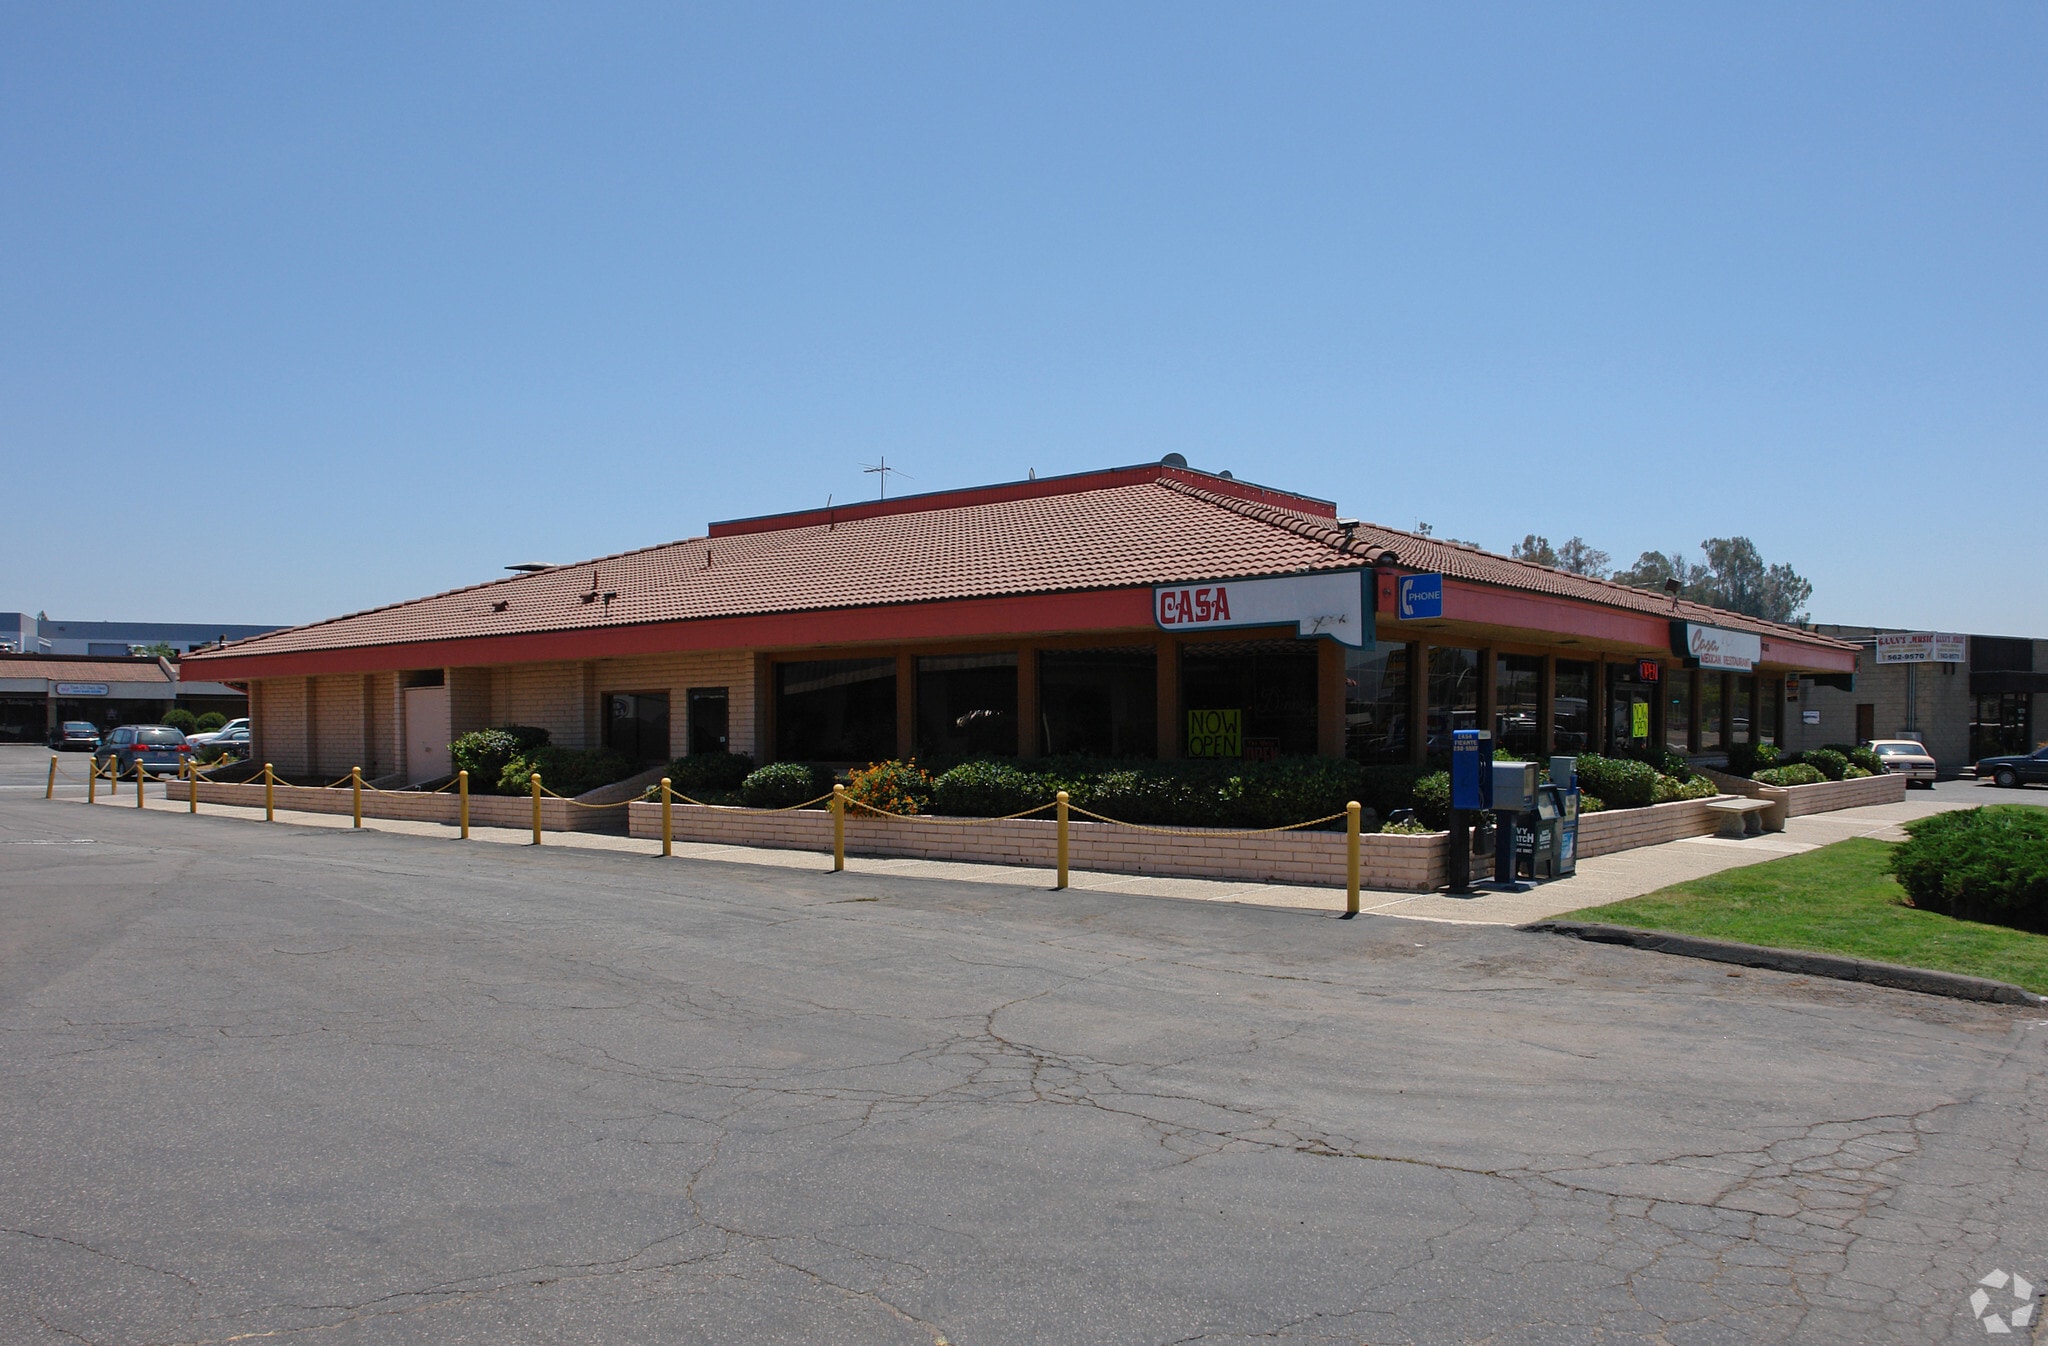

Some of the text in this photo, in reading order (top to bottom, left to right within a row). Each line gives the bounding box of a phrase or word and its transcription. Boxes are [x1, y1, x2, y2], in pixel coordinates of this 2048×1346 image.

[1408, 591, 1441, 602] PHONE
[1160, 587, 1231, 624] CASA
[1692, 628, 1719, 653] Casa
[1909, 635, 1933, 644] MUSIC
[1701, 653, 1751, 667] MEXICAN RESTAURANT
[1887, 653, 1925, 661] 562-9570
[1641, 662, 1659, 681] OPEN
[1191, 711, 1237, 734] NOW
[1633, 720, 1649, 736] OPEN
[1190, 735, 1237, 756] OPEN
[1516, 827, 1528, 835] VY
